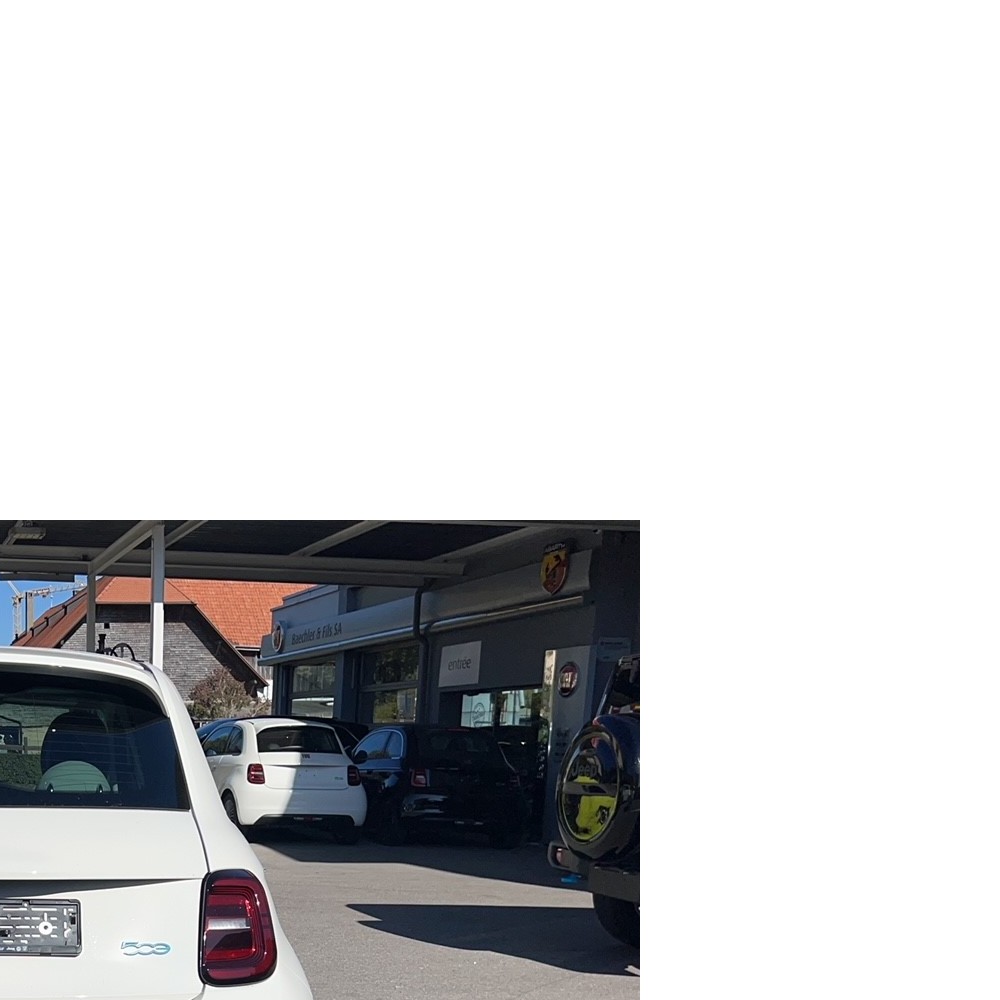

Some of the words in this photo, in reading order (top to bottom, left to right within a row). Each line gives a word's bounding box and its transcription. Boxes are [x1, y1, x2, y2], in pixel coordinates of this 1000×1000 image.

[291, 628, 316, 645] Baechler
[322, 623, 332, 638] Fils
[333, 622, 342, 636] SA
[448, 656, 472, 671] entrée
[571, 763, 598, 777] Jeep
